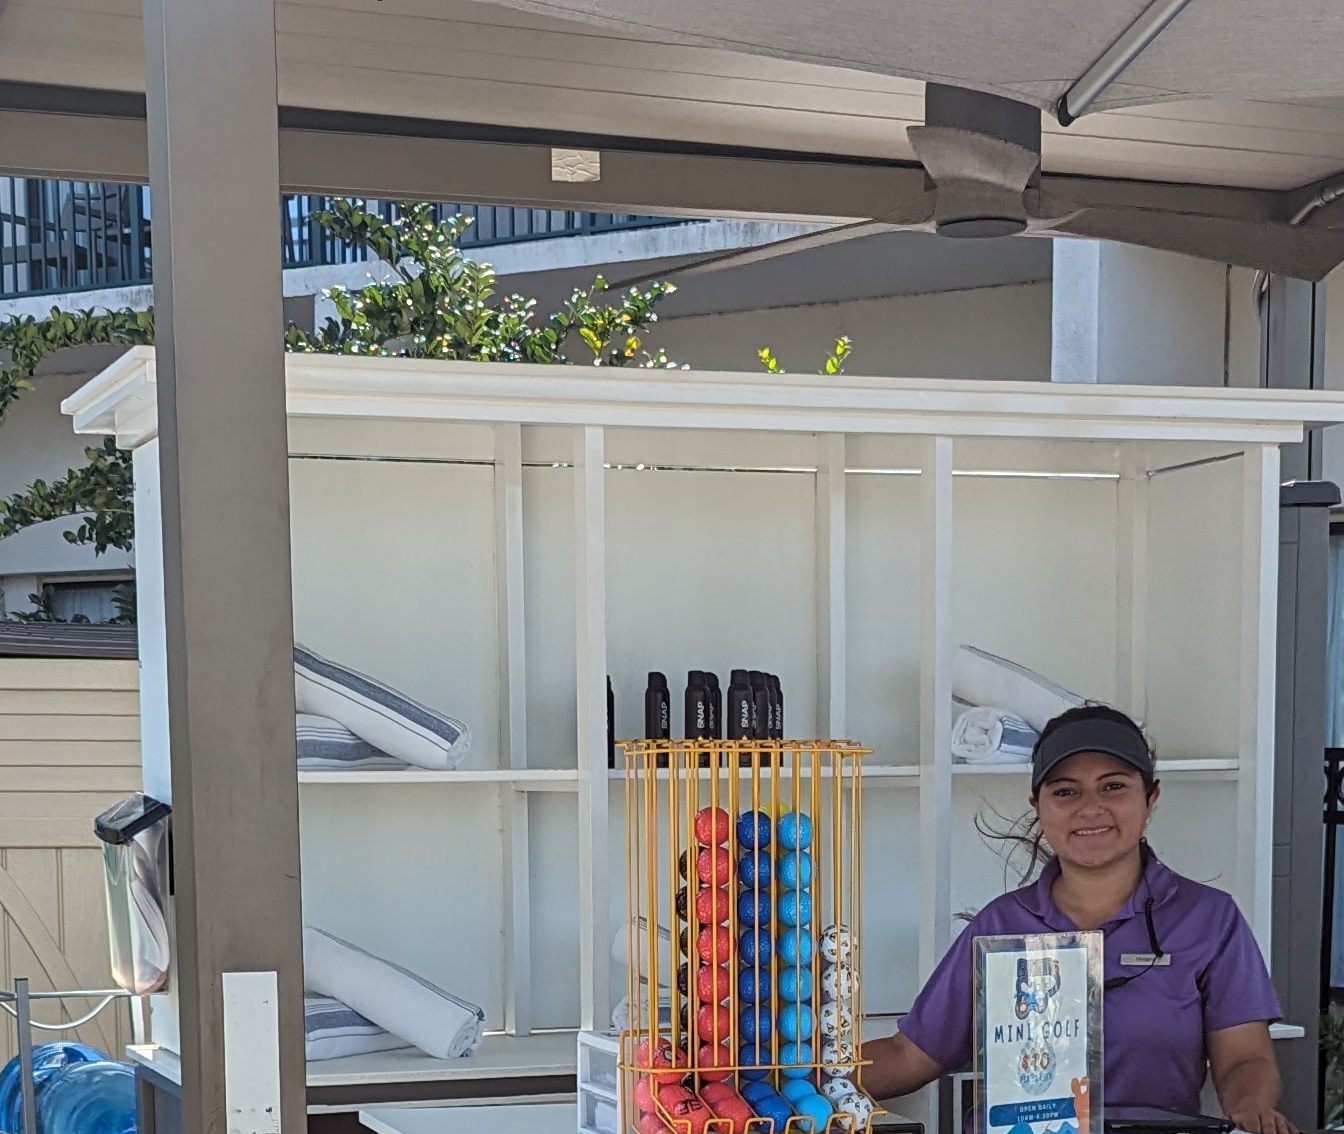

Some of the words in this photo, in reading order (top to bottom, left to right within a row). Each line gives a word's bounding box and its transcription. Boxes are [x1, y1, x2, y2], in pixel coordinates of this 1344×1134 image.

[994, 1023, 1032, 1043] MINI
[1042, 1019, 1079, 1039] GOLF
[1022, 1052, 1049, 1072] $10
[1020, 1104, 1036, 1112] OPEN
